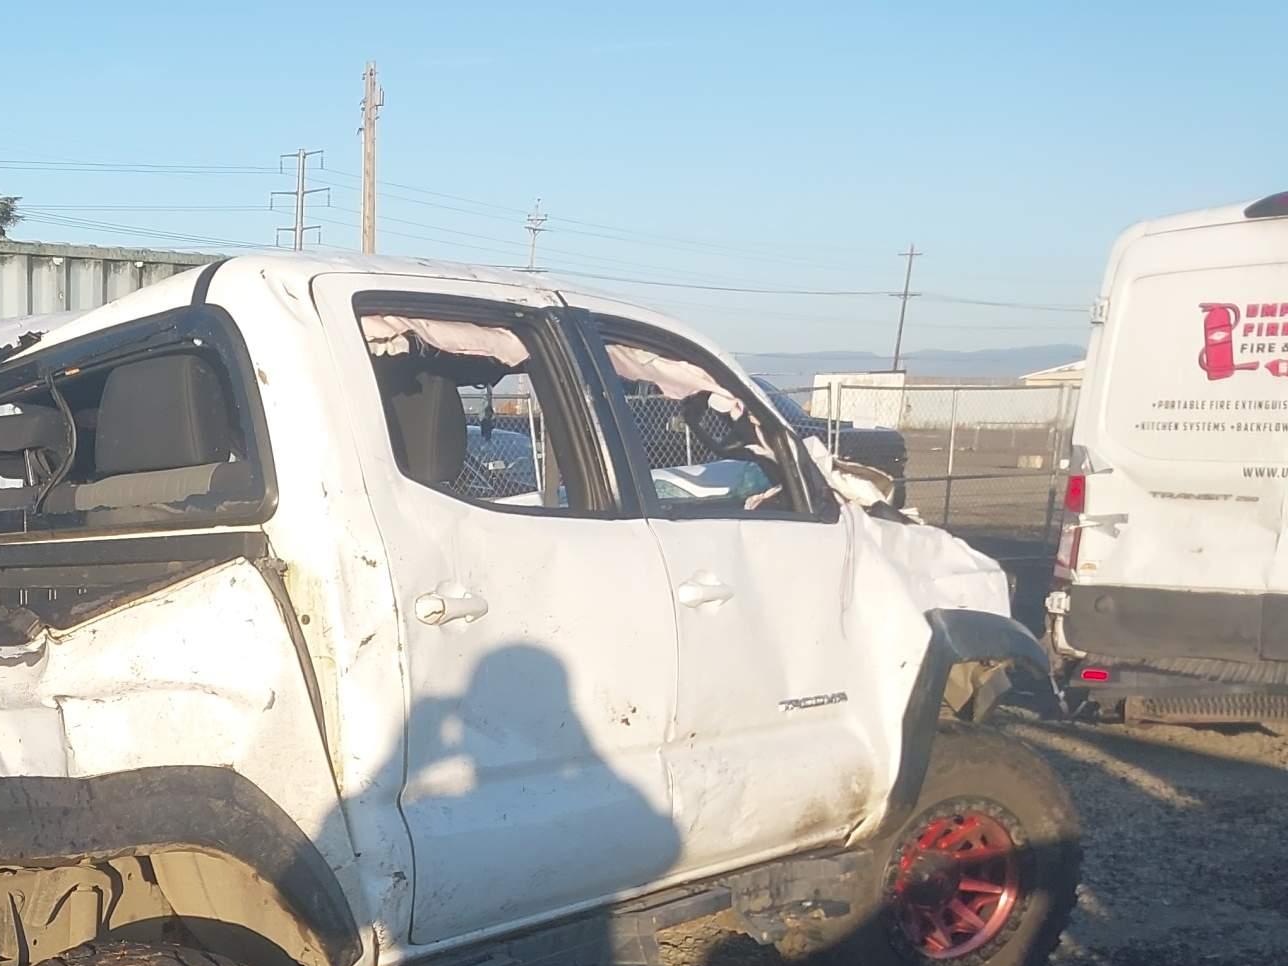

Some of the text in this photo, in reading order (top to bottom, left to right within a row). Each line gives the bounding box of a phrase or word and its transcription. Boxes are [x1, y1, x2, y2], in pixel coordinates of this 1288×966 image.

[1240, 342, 1276, 354] FIRE
[1209, 400, 1231, 410] FIRE
[1182, 422, 1226, 431] SYSTEMS
[1148, 490, 1233, 501] TRANSIT
